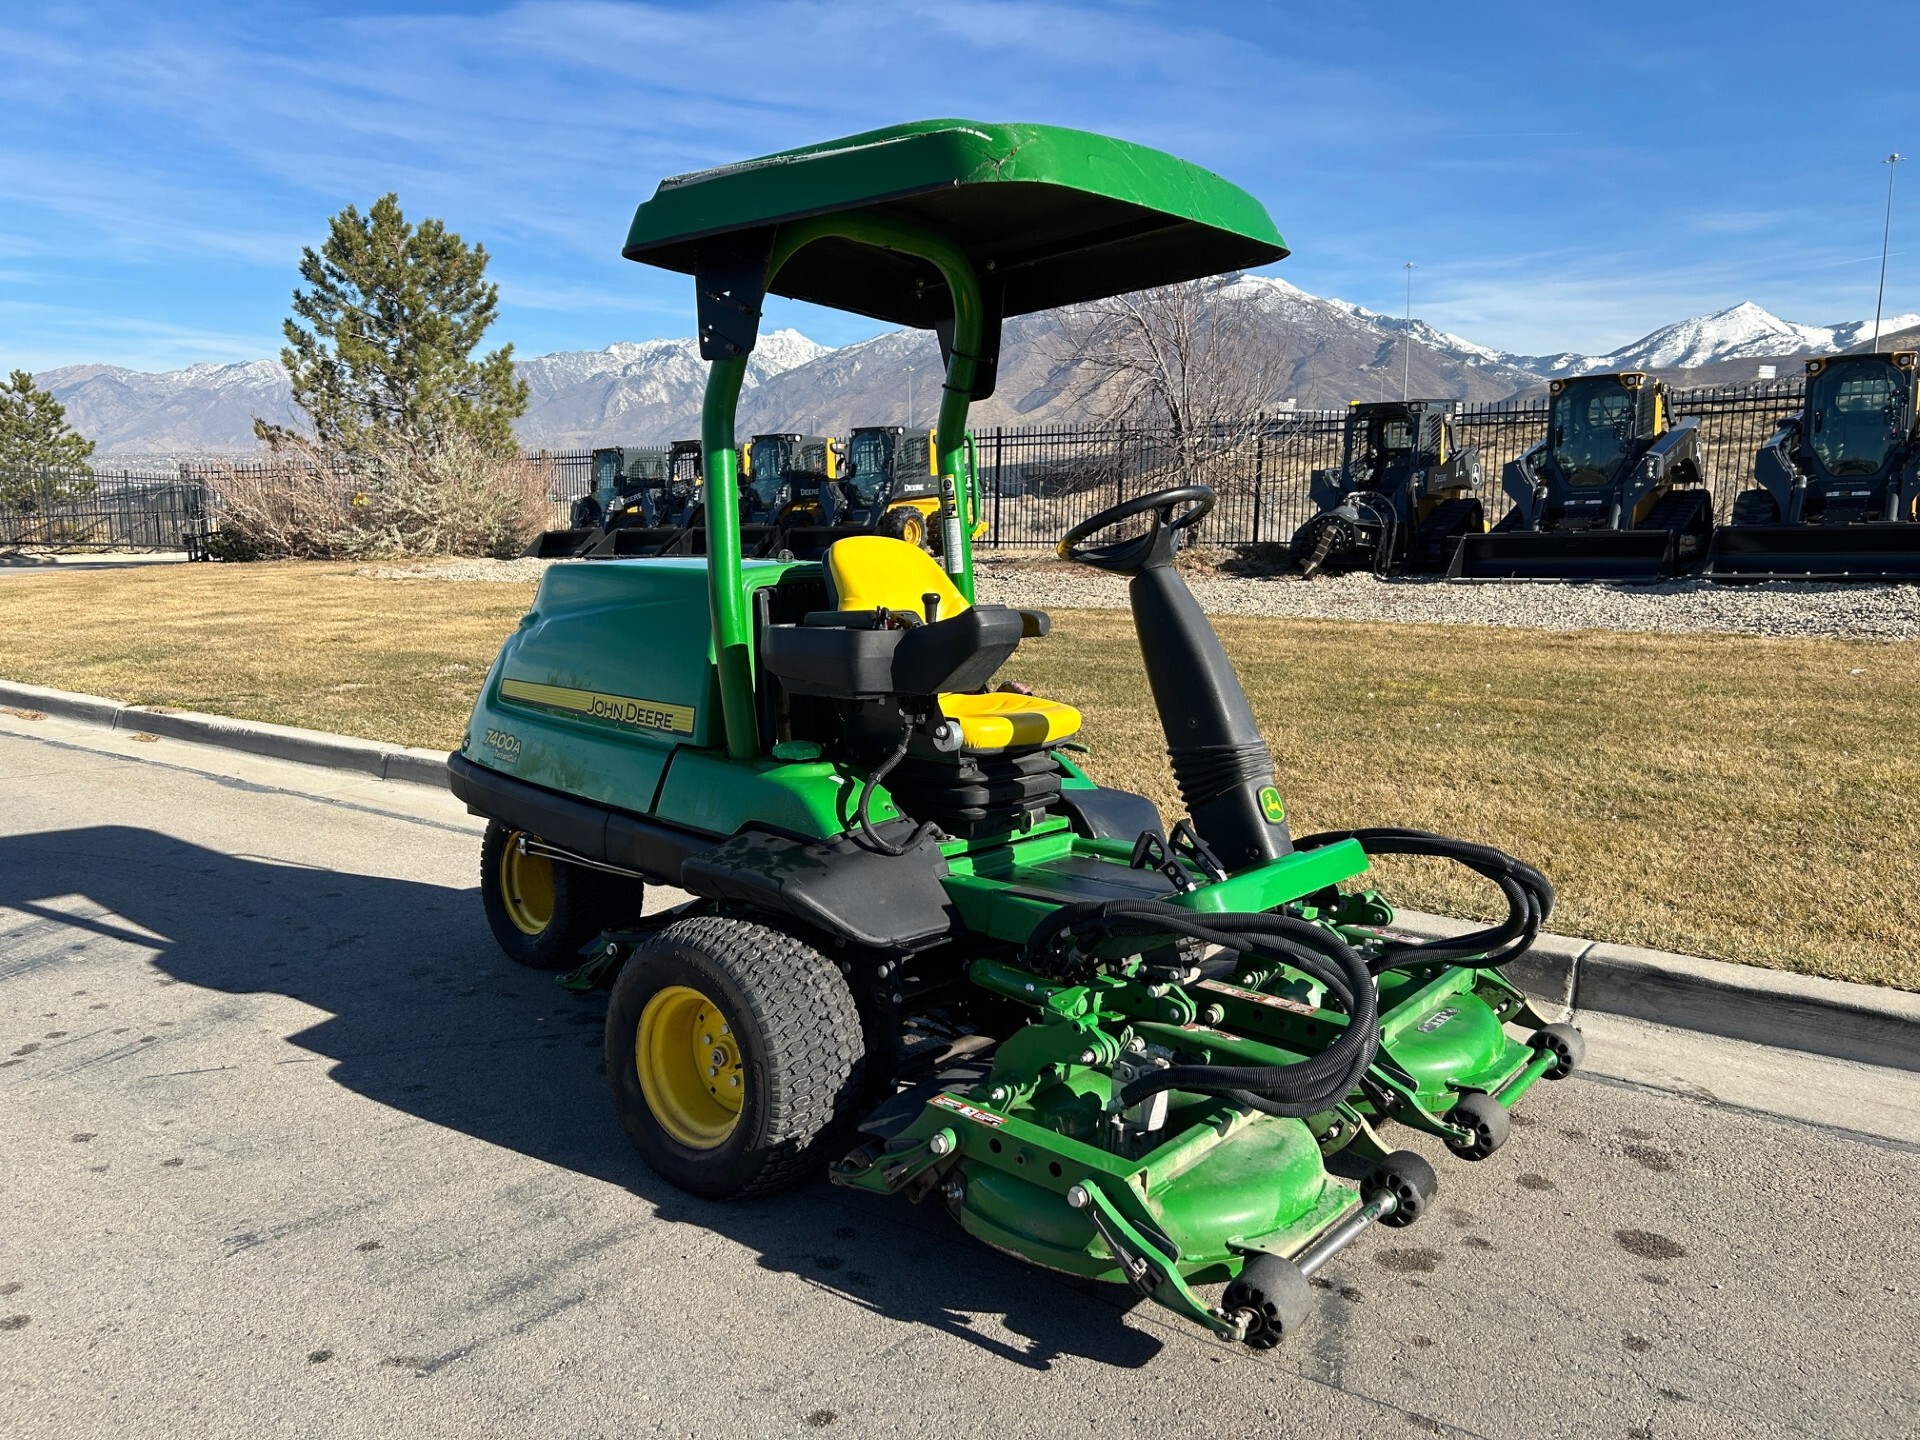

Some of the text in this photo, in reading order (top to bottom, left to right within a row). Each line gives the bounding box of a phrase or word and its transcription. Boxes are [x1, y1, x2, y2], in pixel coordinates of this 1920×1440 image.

[800, 488, 820, 496] DEERE
[904, 483, 925, 492] DEERE
[586, 696, 674, 728] JOHN DEERE
[484, 729, 521, 754] 7400A
